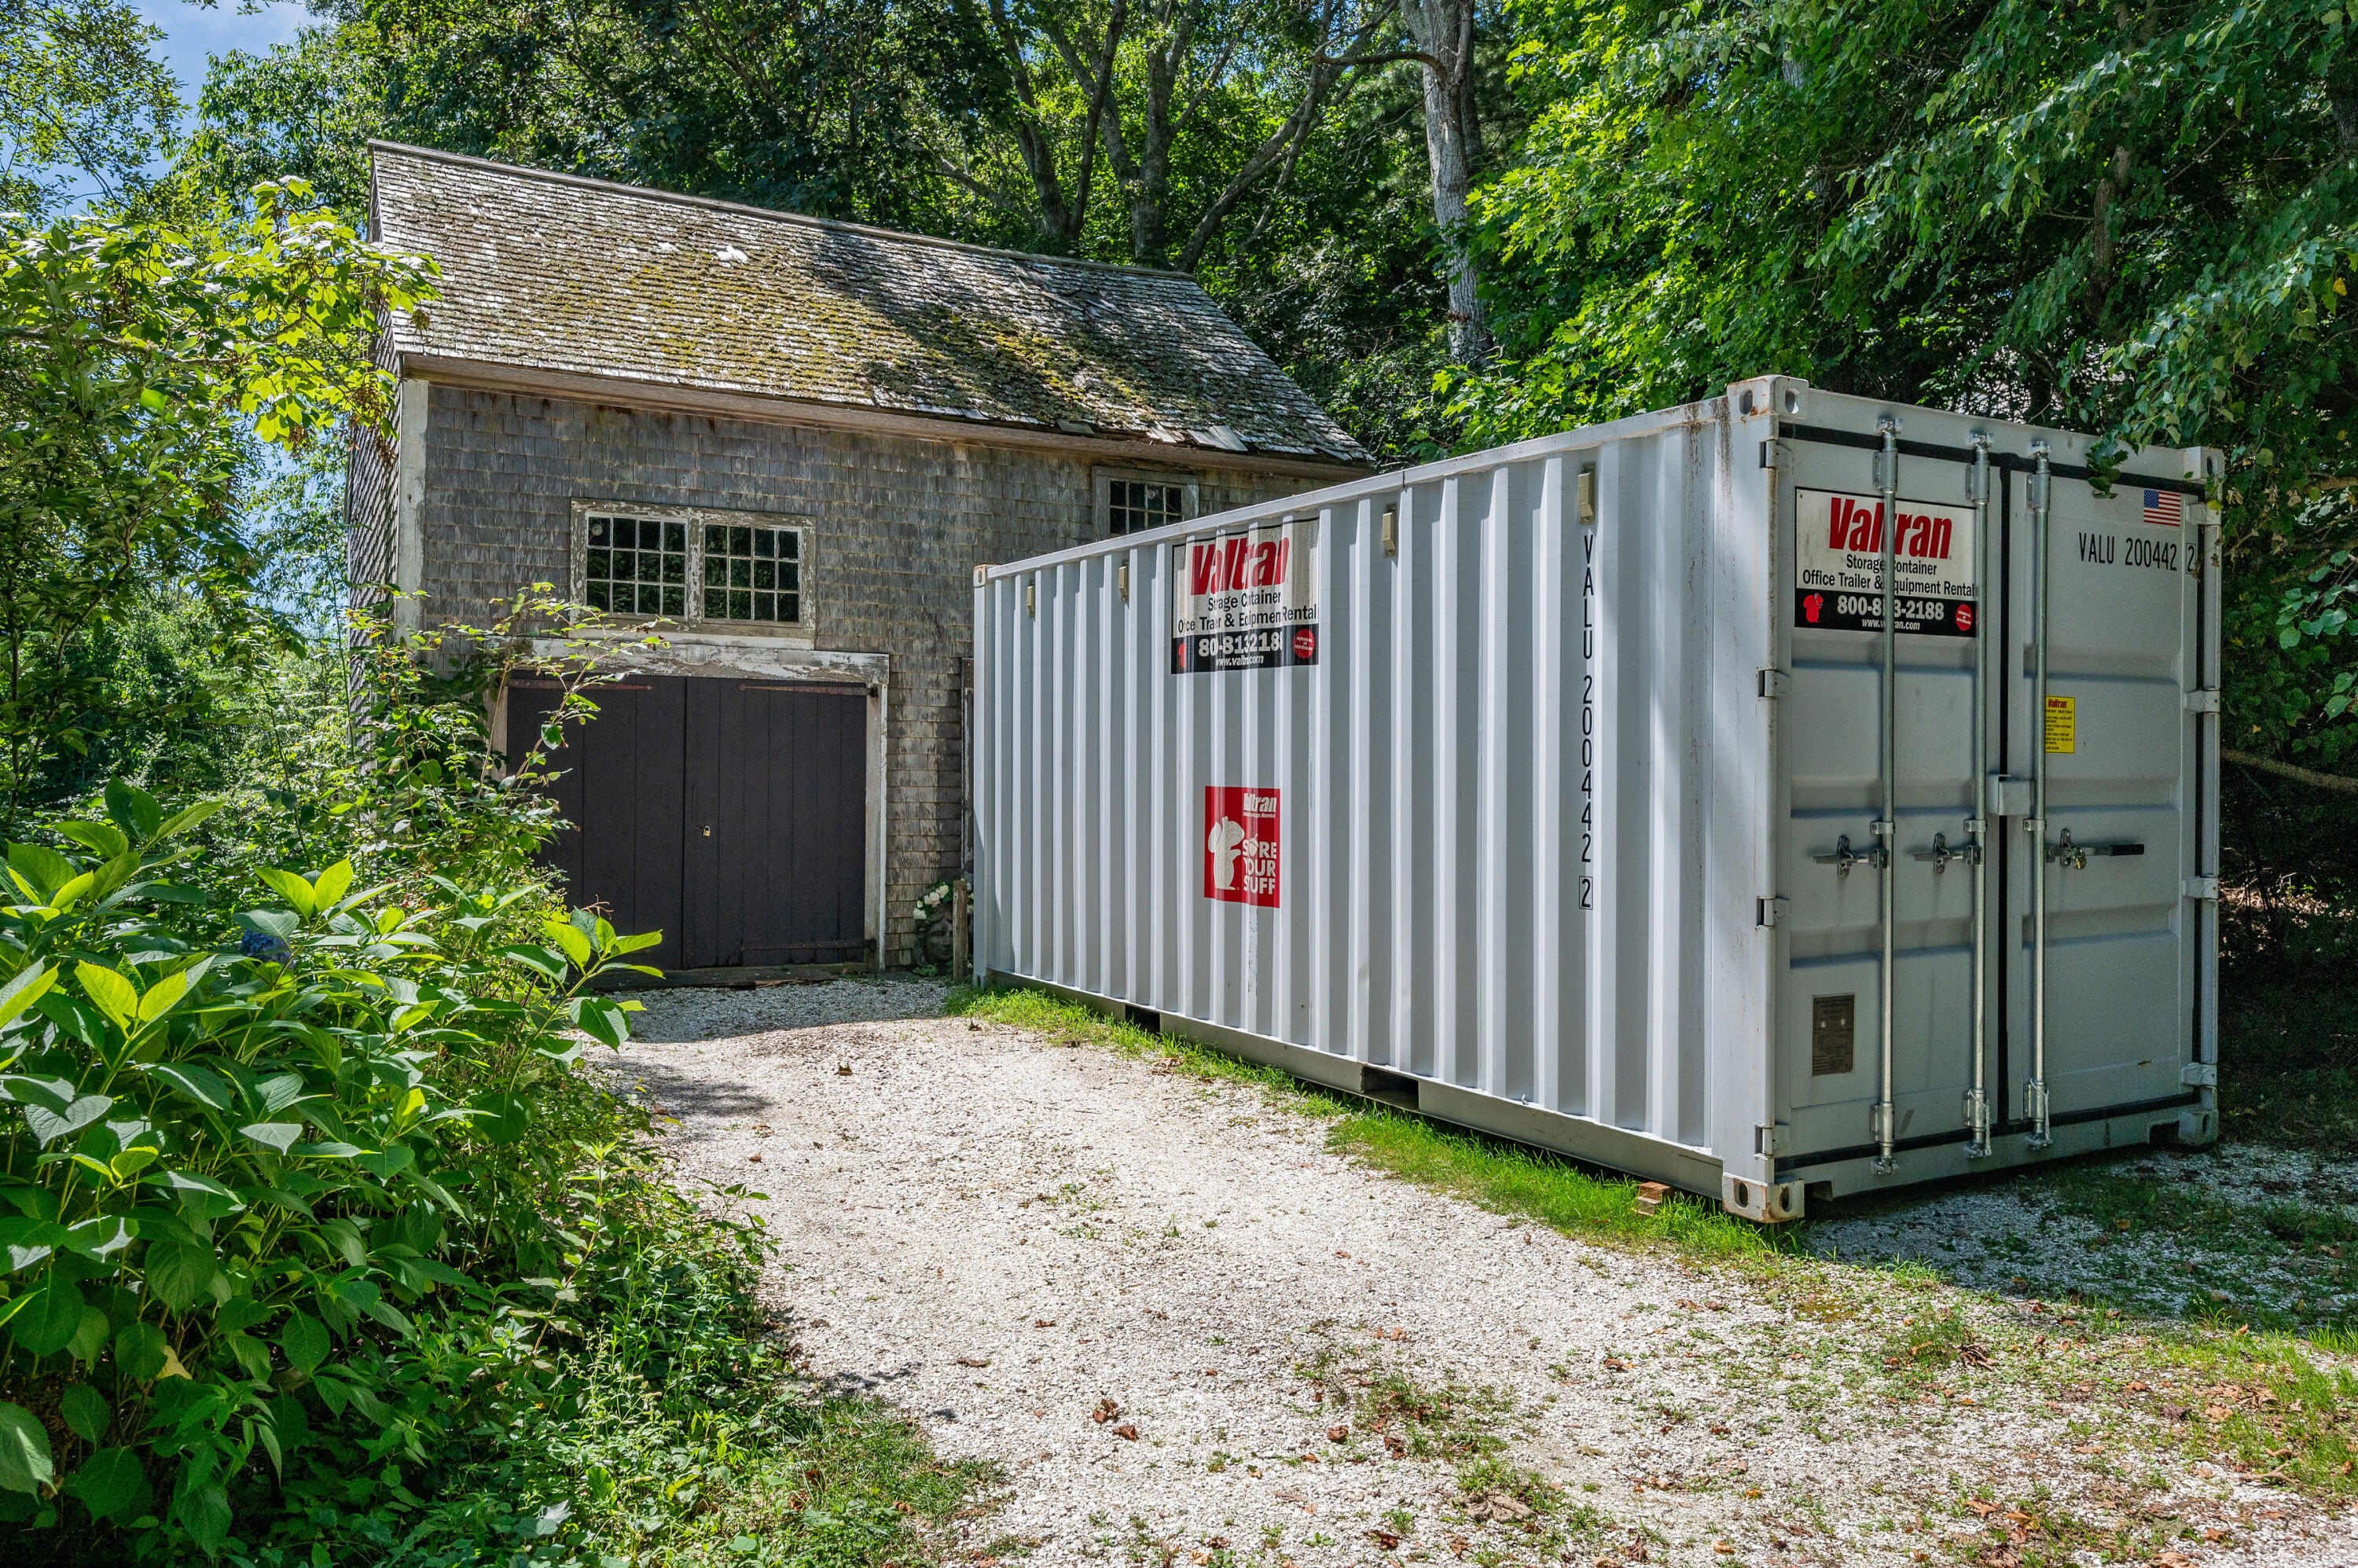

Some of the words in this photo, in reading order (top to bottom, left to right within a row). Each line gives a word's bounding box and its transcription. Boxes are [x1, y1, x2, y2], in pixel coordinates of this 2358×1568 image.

[1829, 497, 1952, 560] Valran
[1846, 553, 1885, 574] Storage
[1893, 560, 1937, 575] ontainer
[2079, 532, 2115, 564] VALU
[2125, 538, 2177, 571] 200442
[2187, 545, 2195, 572] 2
[1802, 569, 1835, 586] Office
[1838, 572, 1871, 589] Trailer
[1874, 575, 1884, 590] &
[1893, 578, 1941, 595] quipment
[1945, 581, 1974, 597] Rental
[1583, 534, 1594, 660] VALU
[1837, 595, 1945, 621] 800-83-2188
[1224, 613, 1235, 628] &
[1283, 604, 1317, 622] Rental
[1862, 619, 1920, 630] www.vran.com
[1581, 674, 1593, 864] 200442
[1243, 857, 1276, 877] YOUR
[1243, 875, 1276, 895] SUFF
[1581, 878, 1592, 909] 2
